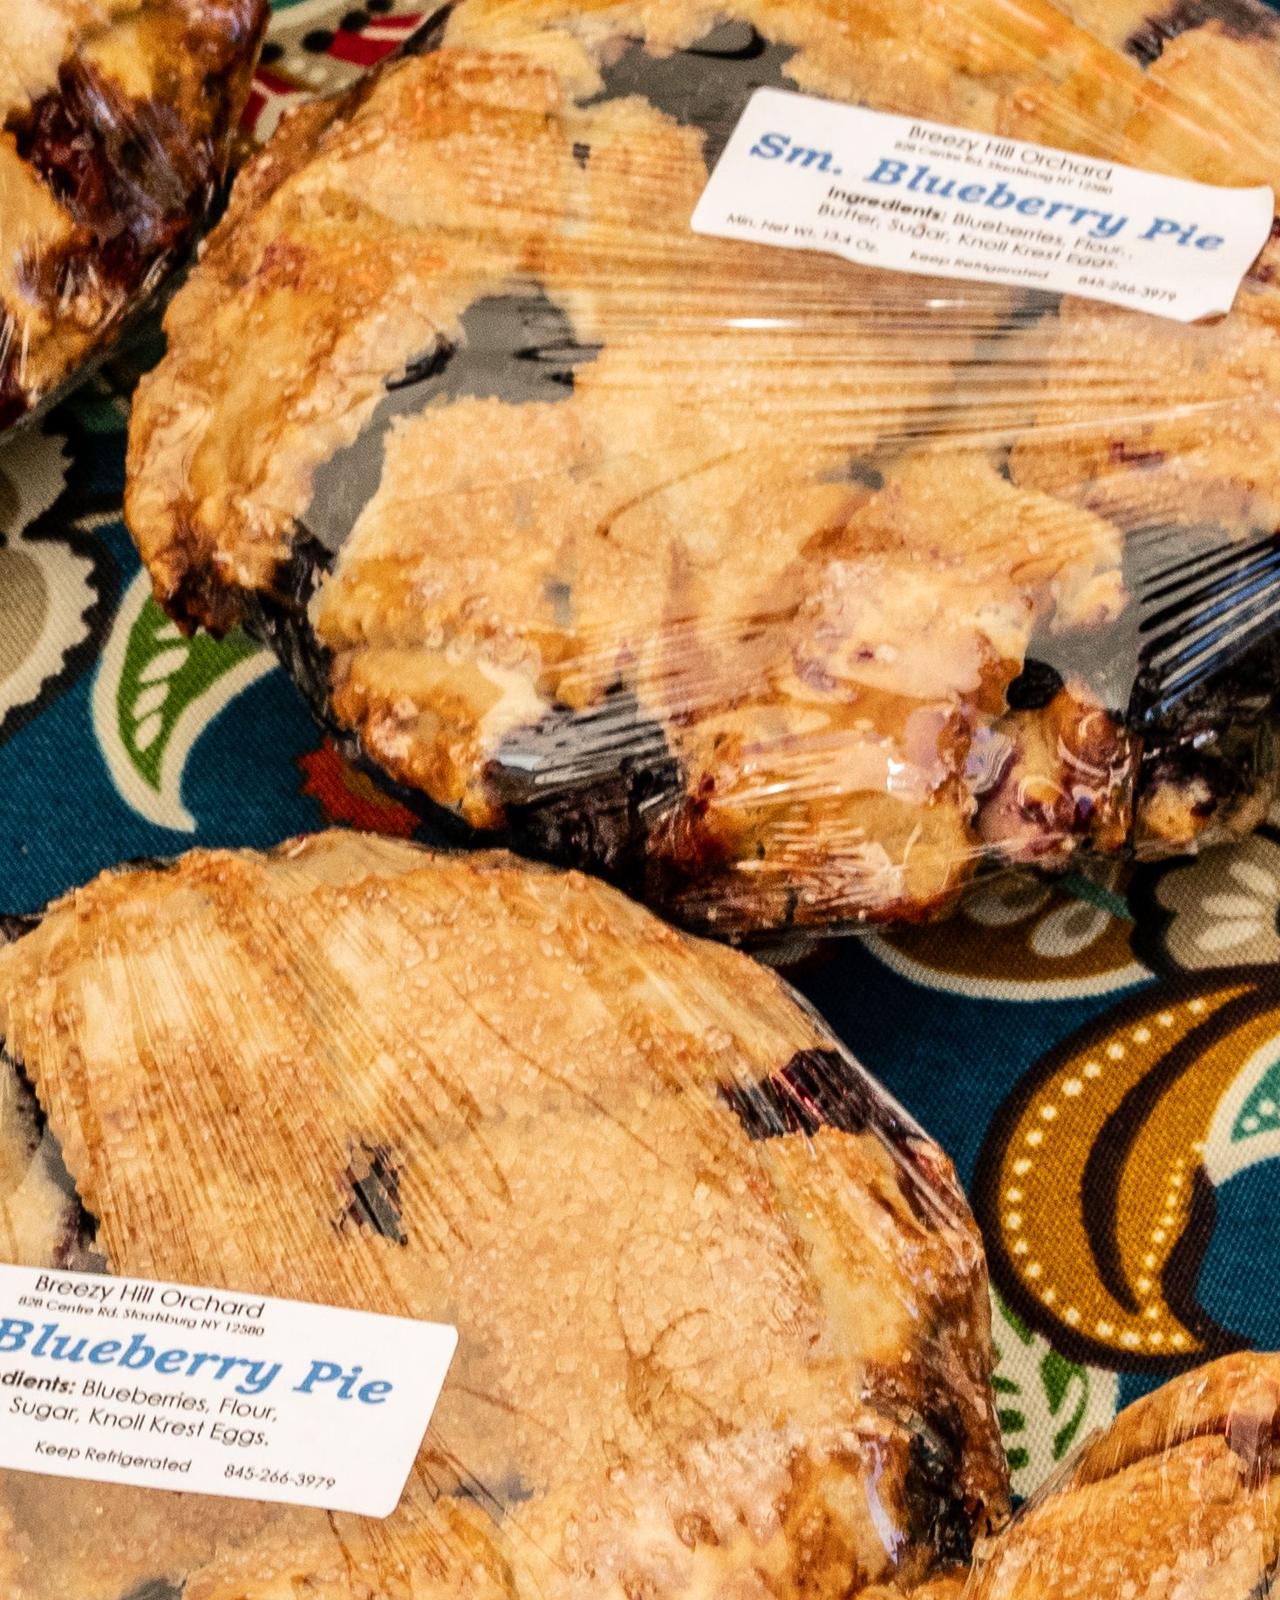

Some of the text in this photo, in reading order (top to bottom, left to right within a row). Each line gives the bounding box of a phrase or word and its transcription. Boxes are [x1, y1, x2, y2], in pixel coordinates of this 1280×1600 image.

[908, 125, 979, 154] Breezy
[984, 141, 1016, 160] Hill
[1021, 151, 1112, 181] Orchard
[751, 134, 842, 175] Sm.
[864, 160, 1127, 238] Blueberry
[1138, 217, 1224, 251] Pie
[34, 1274, 115, 1303] Breezy
[160, 1290, 266, 1319] Orchard
[0, 1318, 393, 1403] Blueberry Pie
[0, 1371, 277, 1422] dients: Blueberries, Flour,
[9, 1397, 79, 1423] Sugar,
[88, 1407, 146, 1431] Knoll
[209, 1422, 269, 1448] Eggs.
[84, 1447, 193, 1473] Refrigerated
[223, 1464, 336, 1490] 845-266-3979
